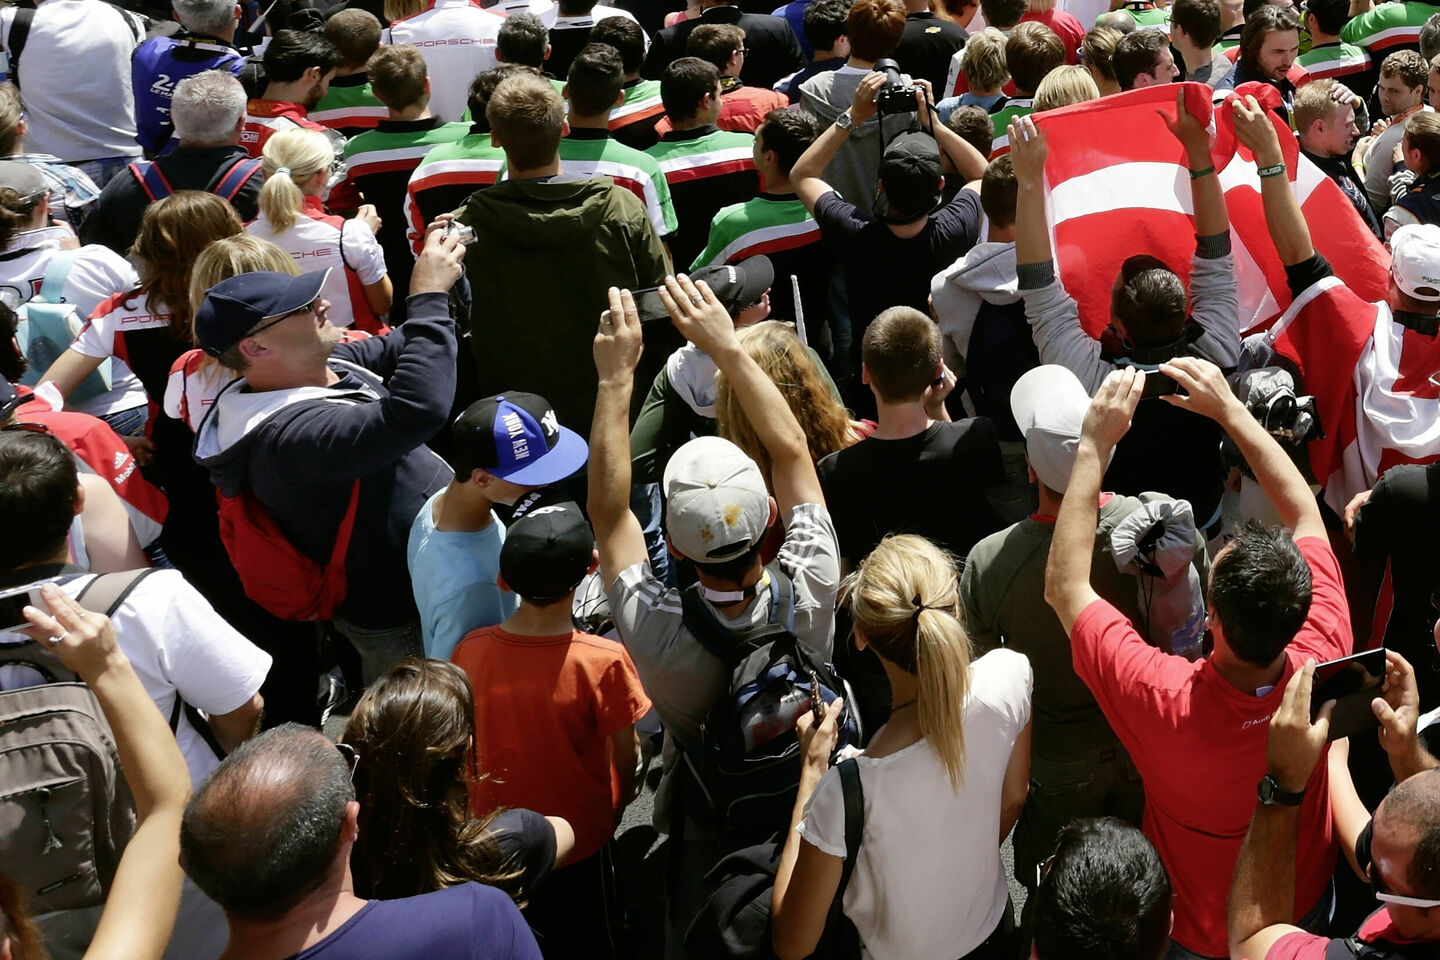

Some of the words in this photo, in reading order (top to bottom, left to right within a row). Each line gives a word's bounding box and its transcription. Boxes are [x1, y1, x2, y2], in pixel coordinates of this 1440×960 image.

[412, 38, 495, 48] PORSCHE
[502, 412, 525, 439] YORK
[512, 438, 530, 460] NEW
